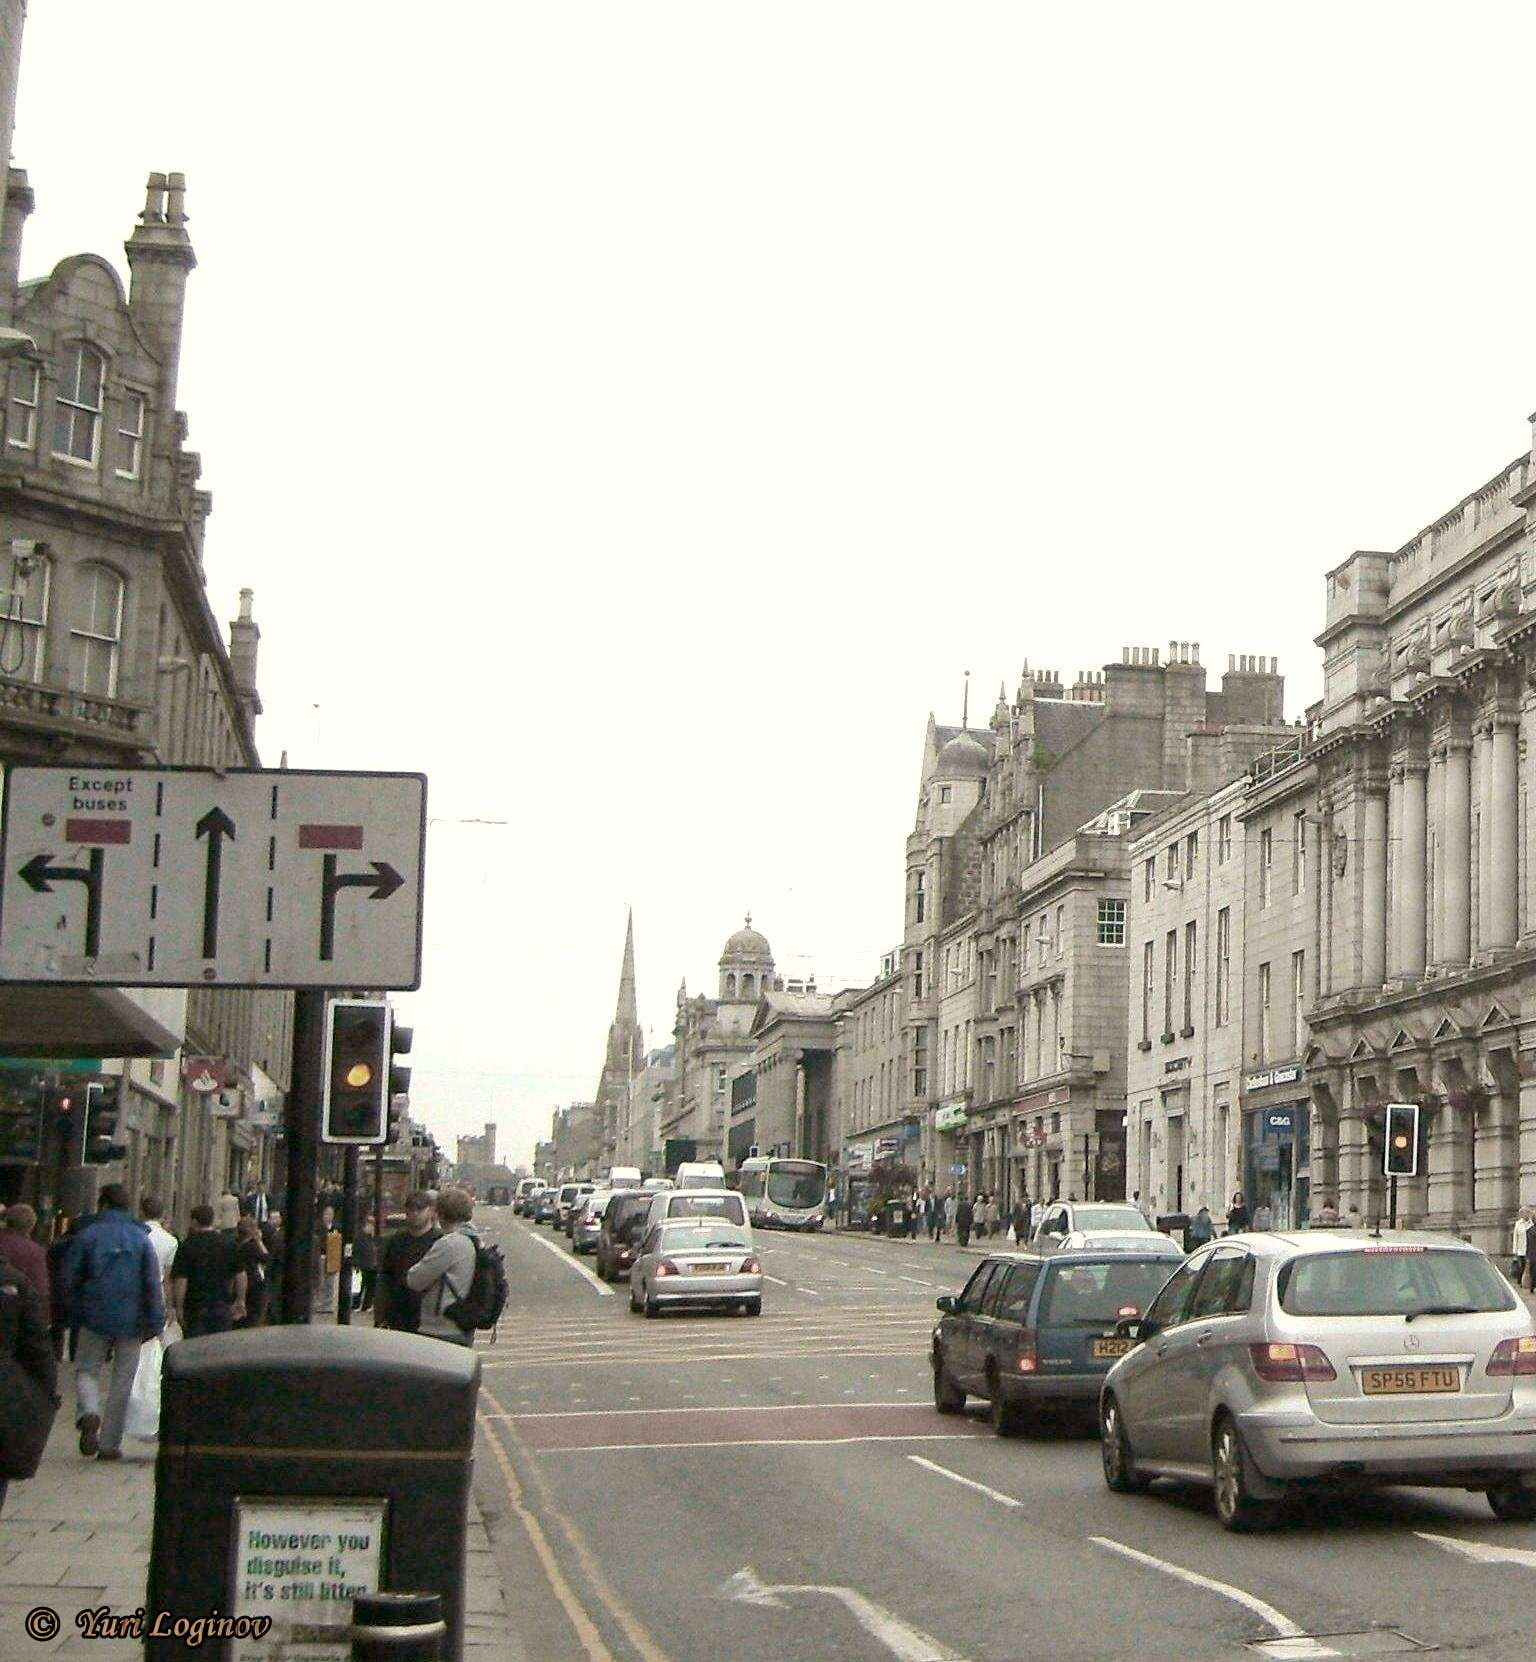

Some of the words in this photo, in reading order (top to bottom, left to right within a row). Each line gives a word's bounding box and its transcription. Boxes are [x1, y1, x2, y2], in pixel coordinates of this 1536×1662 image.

[69, 776, 133, 794] Except
[73, 795, 127, 811] buses
[1371, 1371, 1416, 1389] SP56
[1420, 1371, 1453, 1387] FTU
[248, 1530, 331, 1549] However
[338, 1534, 370, 1553] you
[247, 1556, 322, 1577] disguise
[328, 1556, 346, 1578] it,
[245, 1581, 274, 1600] it's
[281, 1582, 315, 1600] still
